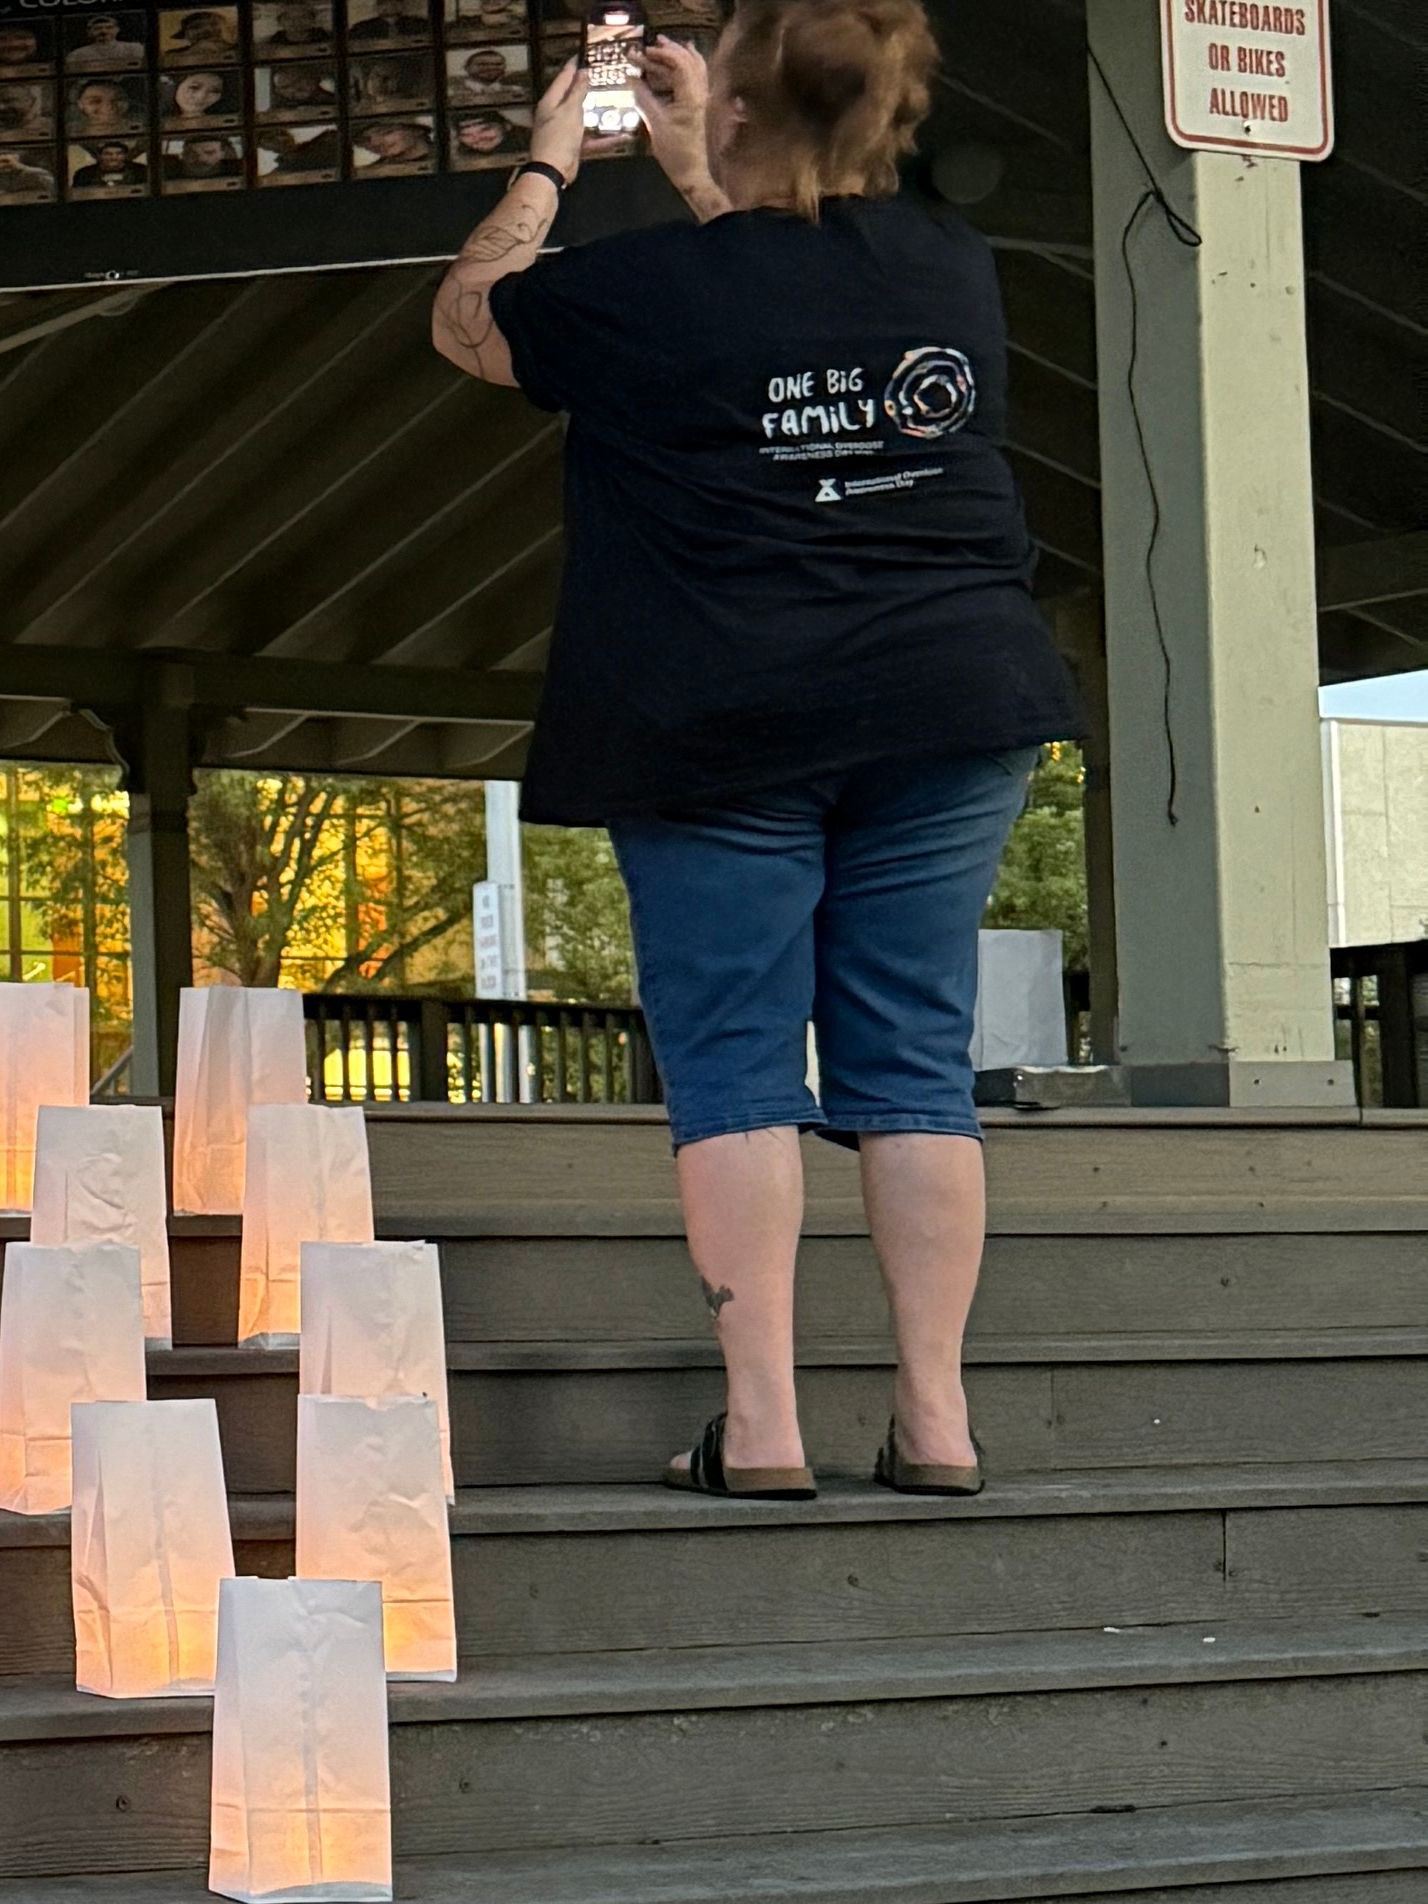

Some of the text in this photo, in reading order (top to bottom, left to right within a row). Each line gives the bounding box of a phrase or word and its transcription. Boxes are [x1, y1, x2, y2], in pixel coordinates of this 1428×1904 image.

[1208, 43, 1286, 78] OR BIKES
[1209, 88, 1289, 123] ALLOWED
[768, 371, 814, 403] ONE
